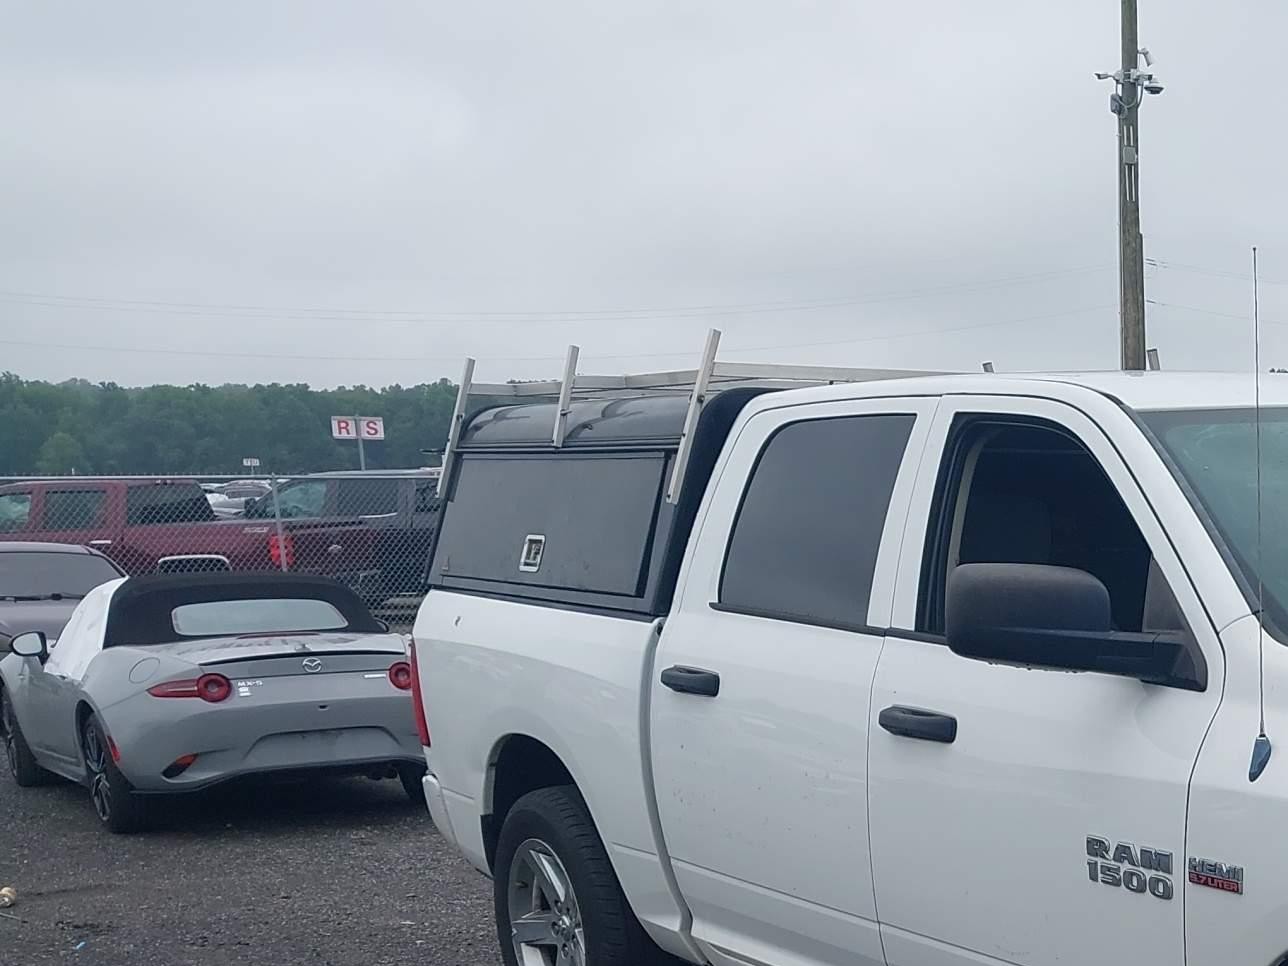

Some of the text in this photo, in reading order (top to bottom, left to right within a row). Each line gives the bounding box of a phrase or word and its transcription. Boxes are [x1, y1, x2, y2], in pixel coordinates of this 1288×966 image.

[337, 420, 350, 435] R
[366, 420, 379, 435] S
[1086, 834, 1173, 875] RAM
[1188, 856, 1243, 881] HEMI
[1087, 859, 1173, 900] 1500
[1207, 877, 1238, 892] LITER
